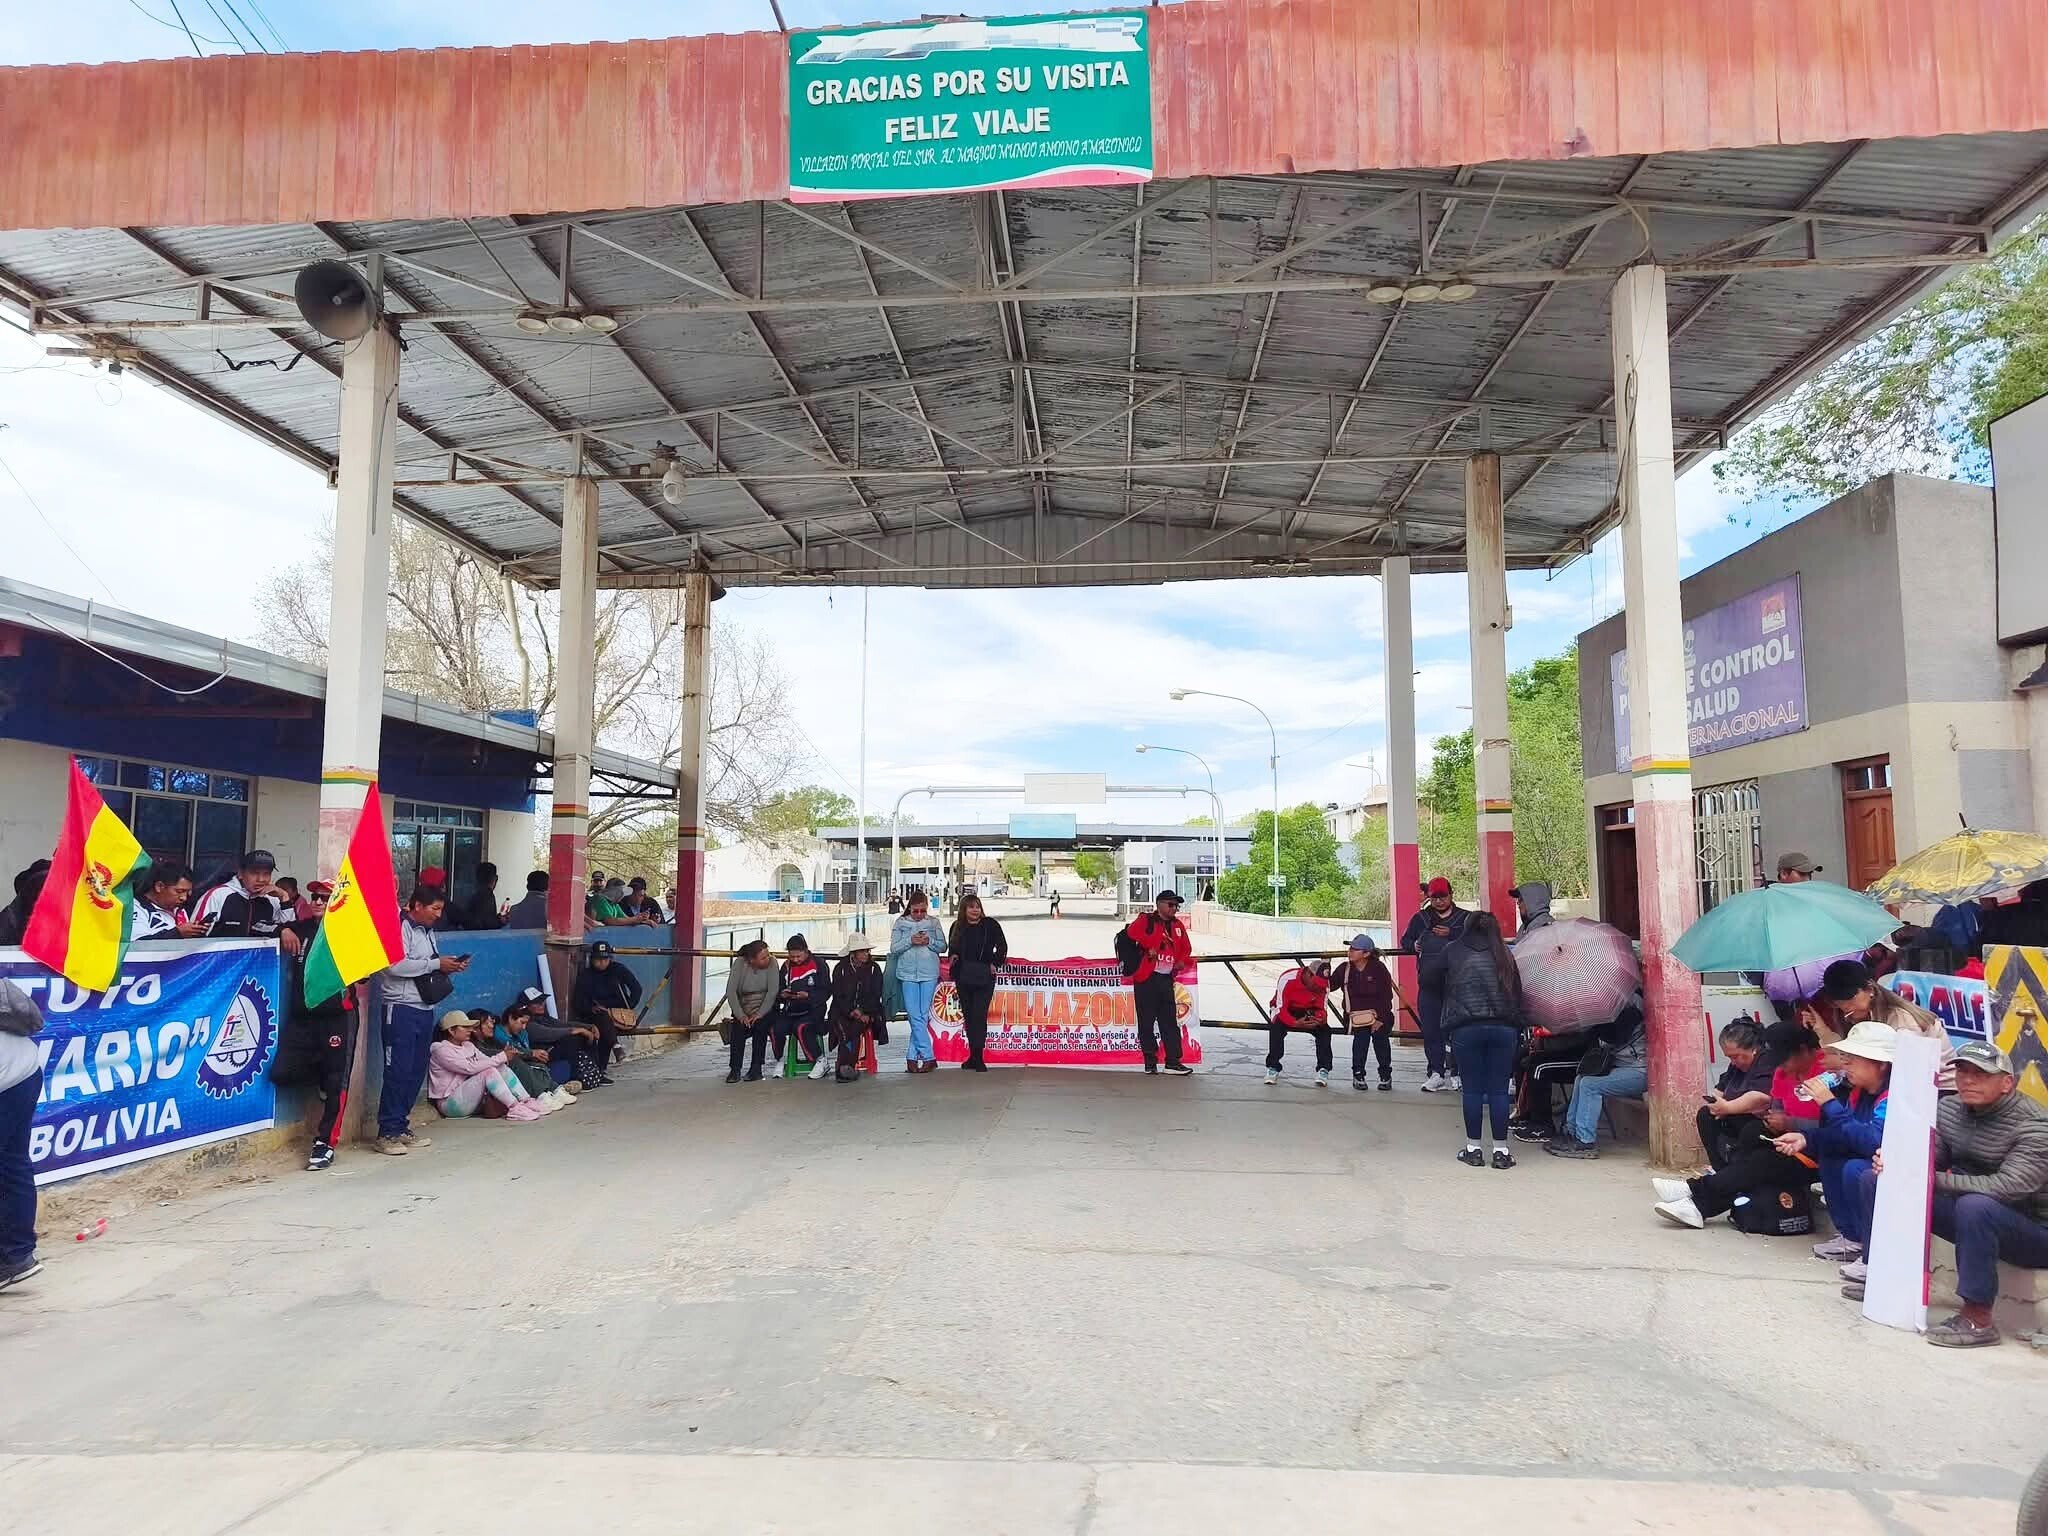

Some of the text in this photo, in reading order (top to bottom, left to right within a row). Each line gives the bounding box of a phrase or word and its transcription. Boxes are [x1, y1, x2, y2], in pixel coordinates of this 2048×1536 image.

[806, 61, 1129, 105] GRACIAS POR SU VISITA
[885, 107, 1050, 143] FELIZ VIAJE
[800, 136, 1143, 173] VILLAZON PORTAL DEL SUR AL MAGICO MUNDO ANDINO AMAZONICO
[1700, 634, 1796, 687] CONTROL
[1686, 687, 1740, 723] SALUD
[1688, 701, 1800, 747] ERNACIONAL
[998, 976, 1121, 987] DE EDUCACIÓN URBANA DE
[1082, 966, 1121, 976] TRABAJ
[1043, 1042, 1057, 1052] que
[1070, 1032, 1084, 1041] que
[1085, 1032, 1099, 1040] nos
[29, 1097, 182, 1163] BOLIVIA
